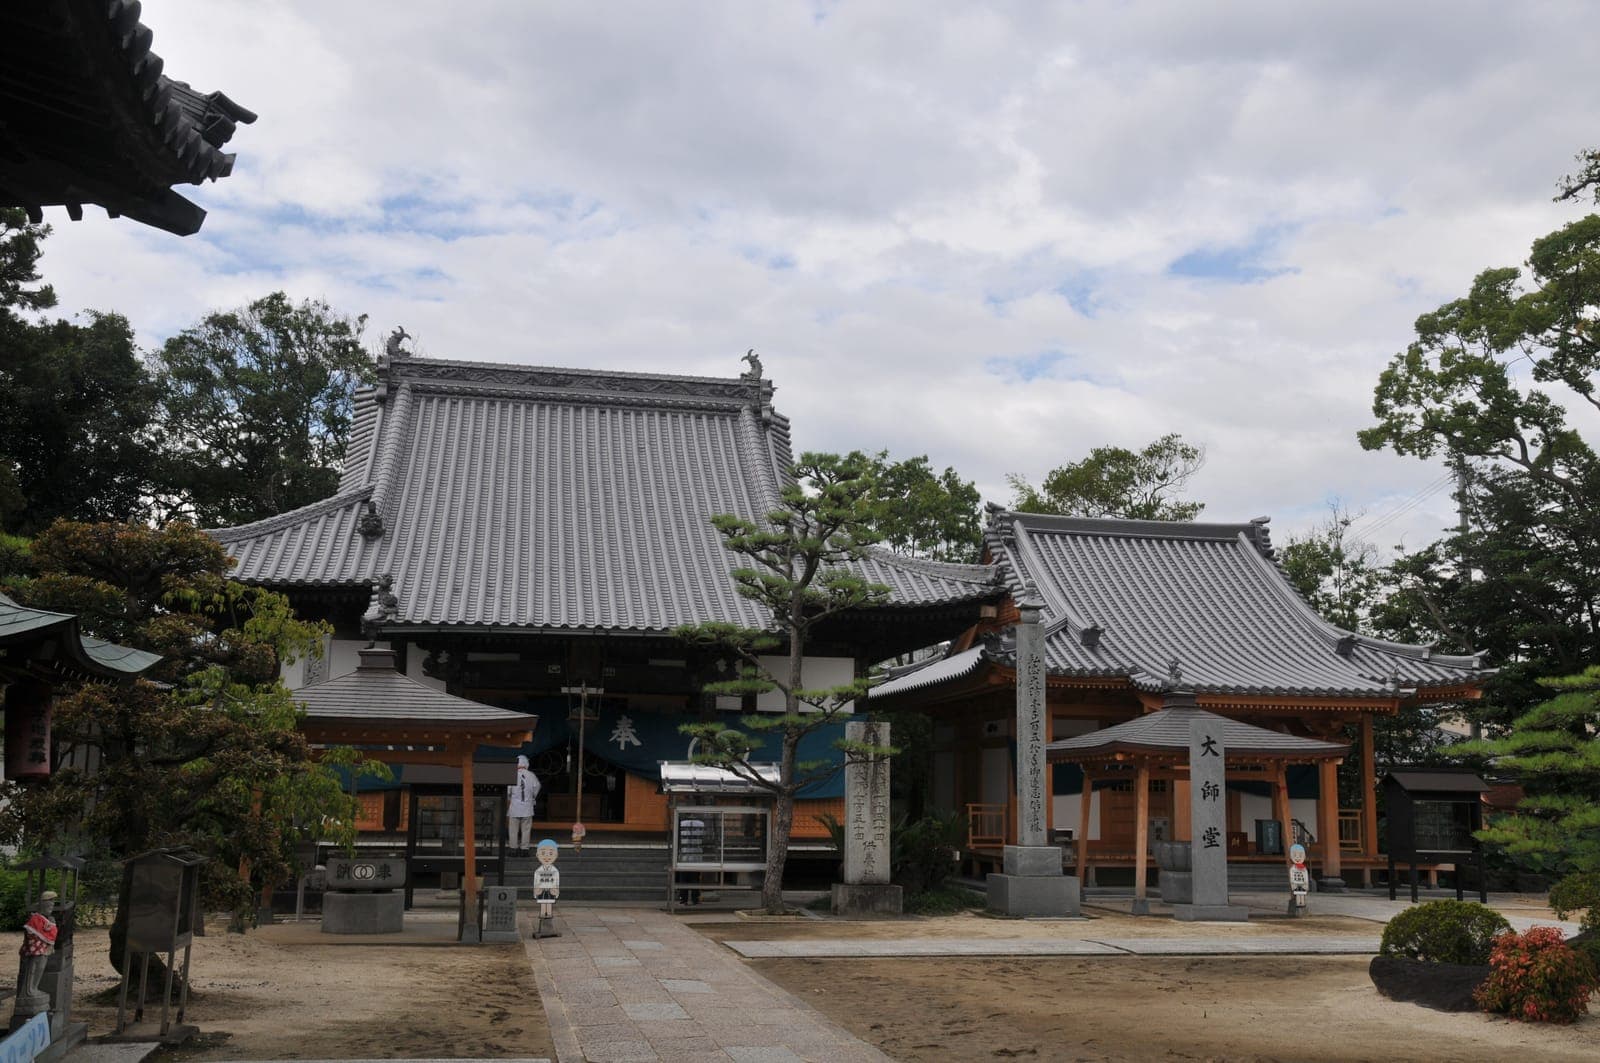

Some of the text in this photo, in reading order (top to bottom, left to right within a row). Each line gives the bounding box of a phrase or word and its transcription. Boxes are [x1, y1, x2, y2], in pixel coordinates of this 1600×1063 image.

[609, 714, 642, 750] 奉
[1200, 735, 1221, 849] 大師堂
